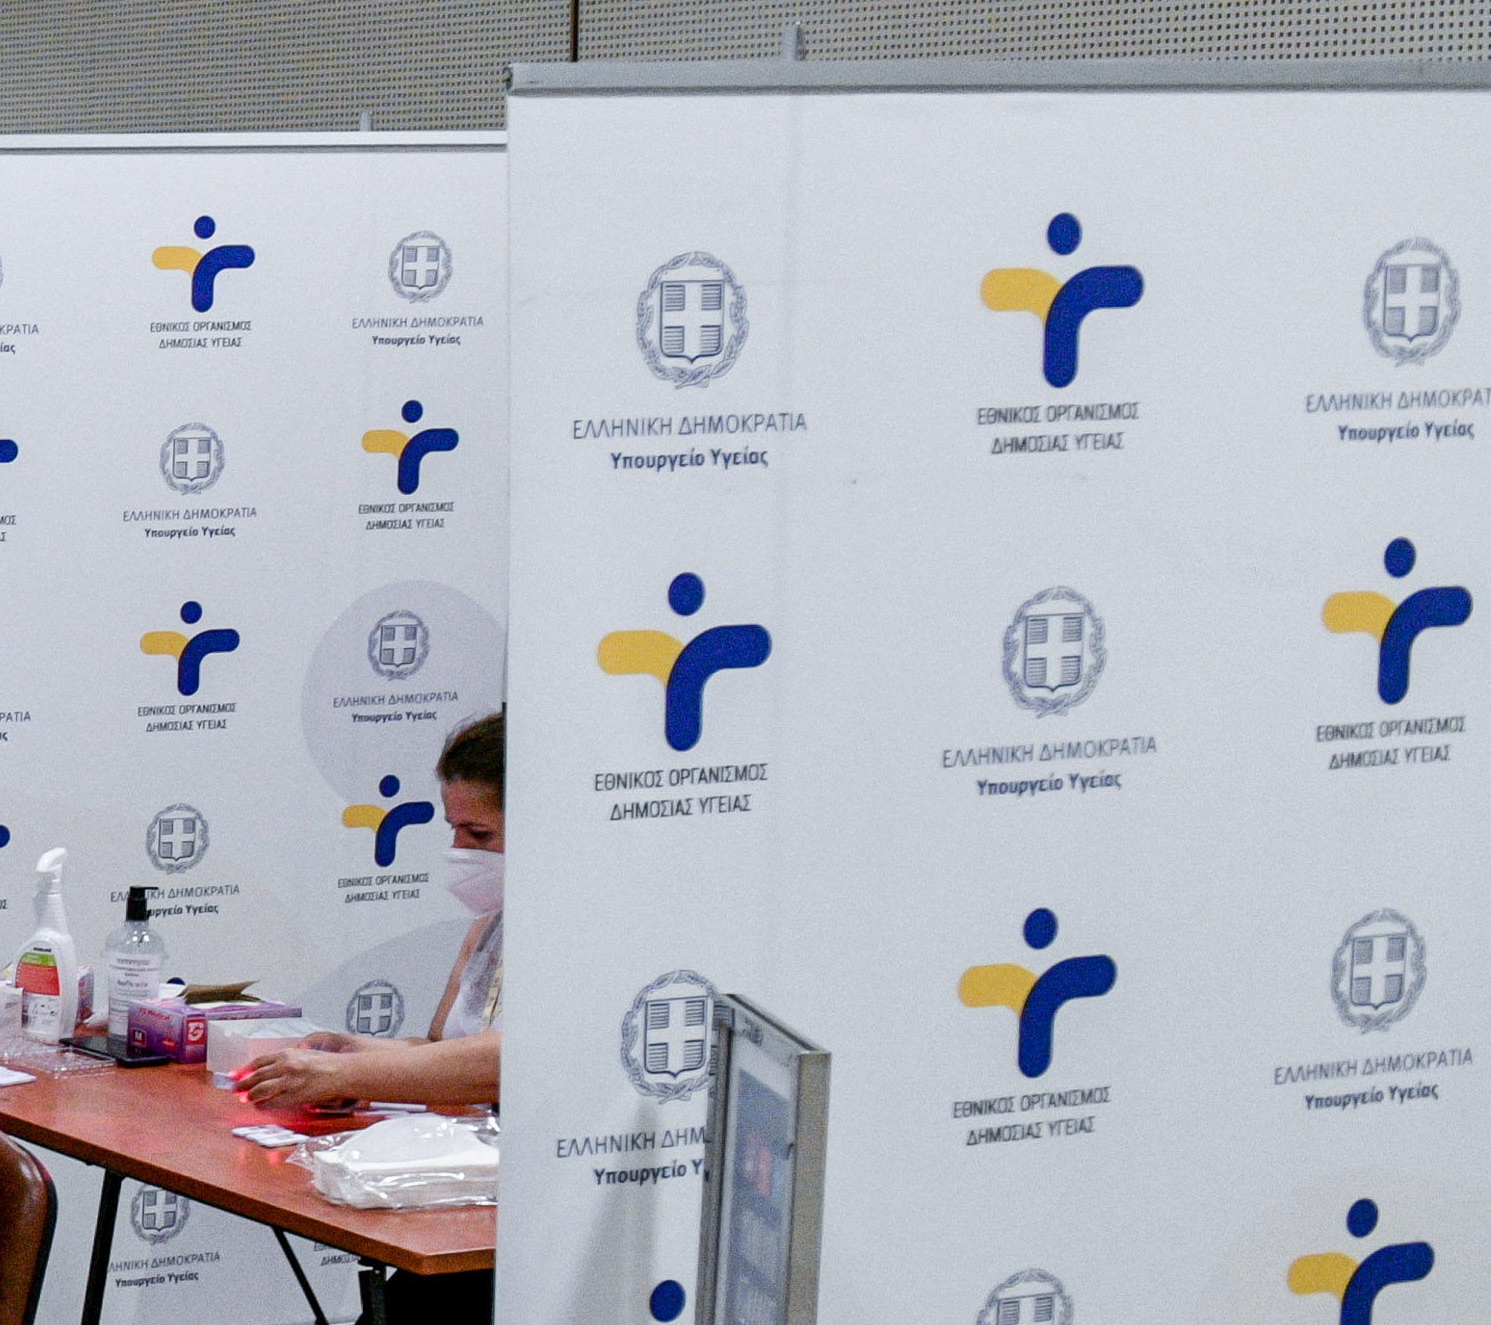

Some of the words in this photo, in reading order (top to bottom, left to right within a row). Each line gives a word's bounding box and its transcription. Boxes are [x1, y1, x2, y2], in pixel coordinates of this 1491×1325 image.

[977, 405, 1040, 425] ΕΘΝΙΚΟΣ
[1046, 402, 1138, 423] ΟΡΓΑΝΙΣΜΟΣ
[1305, 393, 1393, 414] ΕΛΛΗΝΙΚΗ
[1397, 387, 1491, 410] ΔΗΜΟΚΡΑΤ
[573, 417, 672, 440] ΕΛΛΗΝΙΚΗ
[677, 412, 806, 436] ΔΗΜΟΚΡΑΤΙΑ
[1337, 422, 1420, 444] Υπουργείο
[1424, 419, 1475, 441] Υγείας
[990, 434, 1069, 455] ΔΗΜΟΣΙΑΣ
[1075, 431, 1123, 450] ΥΓΕΙΑΣ
[610, 450, 706, 473] Υπουργείο
[710, 446, 769, 470] Υγείας
[1316, 721, 1374, 743] ΕΘΝΙΚΟΣ
[1380, 716, 1465, 738] ΟΡΓΑΝΙΣΜΟΣ
[942, 745, 1034, 769] ΕΛΛΗΝΙΚΗ
[1038, 736, 1157, 762] ΔΗΜΟΚΡΑΤΙΑ
[1328, 748, 1399, 770] ΔΗΜΟΣΙΑΣ
[1405, 744, 1450, 763] ΥΓΕΙΑΣ
[594, 769, 663, 792] ΕΘΝΙΚΟΣ
[668, 762, 768, 787] ΟΡΓΑΝΙΣΜΟΣ
[976, 776, 1064, 797] Υπουργείο
[1068, 771, 1122, 793] Υγείας
[609, 797, 693, 822] ΔΗΜΟΣΙΑΣ
[699, 793, 751, 814] ΥΓΕΙΑΣ
[1274, 1060, 1358, 1086] ΕΛΛΗΝΙΚΗ
[1361, 1048, 1473, 1076] ΔΗΜΟΚΡΑΤΙΑ
[953, 1096, 1015, 1119] ΕΘΝΙΚΟΣ
[1020, 1086, 1110, 1112] ΟΡΓΑΝΙΣΜΟΣ
[1304, 1088, 1385, 1110] Υπουργείο
[1388, 1082, 1439, 1104] Υγείας
[557, 1131, 657, 1158] ΕΛΛΗΝΙΚΗ
[965, 1121, 1042, 1147] ΔΗΜΟΣΙΑΣ
[1048, 1115, 1094, 1136] ΥΓΕΙΑΣ
[593, 1159, 687, 1187] Υπουργείο
[108, 1259, 148, 1273] ΛΗΝΙΚΗ
